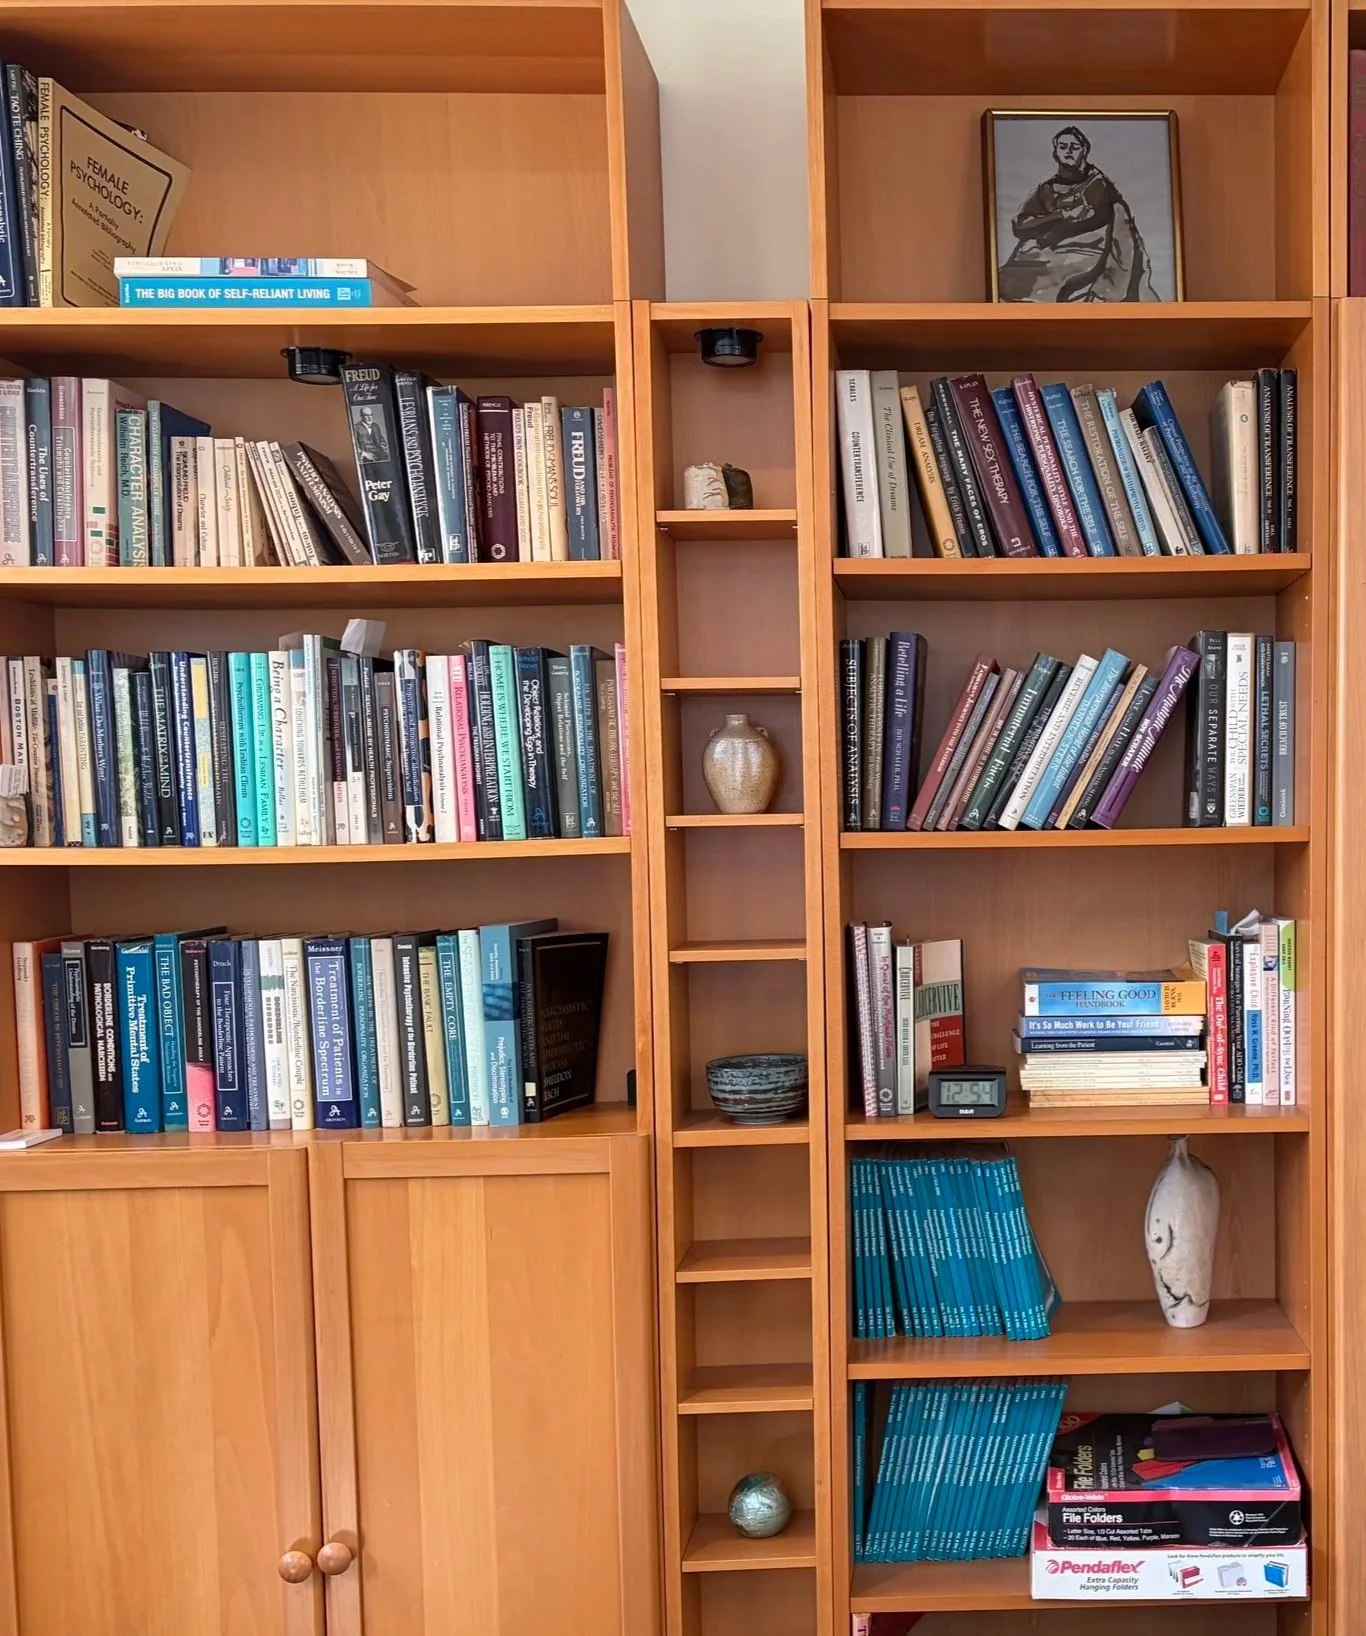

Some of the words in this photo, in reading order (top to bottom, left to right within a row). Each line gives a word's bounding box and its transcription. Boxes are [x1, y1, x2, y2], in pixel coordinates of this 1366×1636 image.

[11, 94, 19, 113] TAO
[41, 82, 49, 120] FEMALE
[12, 114, 21, 126] TE
[14, 128, 24, 160] CHING
[40, 126, 49, 200] PSYCHOLOGY:
[87, 156, 129, 195] FEMALE
[70, 161, 144, 224] PSYCHOLOGY:
[71, 199, 100, 228] Annotated
[101, 222, 136, 254] Bibliography
[135, 288, 155, 299] THE
[158, 288, 175, 299] BIG
[178, 288, 206, 298] BOOK
[209, 288, 221, 298] OF
[224, 288, 294, 298] SELF-RELIANT
[297, 288, 330, 298] LIVING
[345, 369, 380, 382] FREUD
[400, 397, 416, 435] LESBIANS
[883, 407, 891, 421] The
[969, 397, 983, 418] THE
[1286, 385, 1294, 422] ANALYSIS
[119, 417, 129, 448] Wilhelm
[884, 423, 895, 454] Clinical
[976, 419, 990, 442] NEW
[1264, 424, 1271, 434] OF
[1286, 423, 1294, 433] OF
[38, 447, 47, 464] The
[406, 436, 417, 450] AND
[571, 432, 585, 479] FREUD
[982, 443, 997, 462] SEX
[120, 453, 129, 477] Reich,
[129, 416, 143, 500] CHARACTER
[852, 432, 864, 502] COUNTERTRANSFERENCE
[887, 456, 895, 469] Use
[1264, 435, 1272, 496] TRANSFERENCE
[1286, 435, 1294, 495] TRANSFERENCE
[28, 424, 38, 522] Countertransference
[39, 467, 47, 489] Uses
[365, 480, 392, 491] Peter
[407, 450, 428, 517] PSYCHOANALYSIS
[989, 464, 1009, 504] THERAPY
[40, 492, 49, 502] of
[122, 480, 131, 498] M.D.
[368, 491, 390, 502] Gay
[889, 482, 898, 511] Dreams
[270, 660, 284, 693] Being
[494, 661, 503, 691] HOME
[894, 641, 910, 686] Retelling
[1174, 665, 1191, 688] The
[155, 687, 165, 708] THE
[497, 693, 504, 701] IS
[531, 680, 539, 704] Object
[844, 659, 857, 720] SUBJECTS
[1209, 684, 1219, 704] OUR
[1239, 672, 1248, 712] NEEDS
[498, 703, 507, 737] WHERE
[522, 694, 534, 735] Developing
[894, 698, 908, 717] Life
[1000, 688, 1038, 752] Immaterial
[1153, 684, 1178, 730] Analytic
[1261, 691, 1269, 727] LETHAL
[157, 711, 167, 754] MATRIX
[435, 706, 443, 739] Relational
[532, 706, 542, 738] Relations
[848, 724, 857, 741] OF
[1139, 718, 1150, 733] ROY
[1207, 709, 1218, 763] SEPARATE
[274, 708, 287, 770] Character
[501, 740, 509, 756] WE
[1121, 734, 1144, 767] SCHAFER
[1131, 727, 1161, 772] Attitude
[1238, 720, 1247, 764] SPECIAL
[1260, 729, 1269, 769] SECRETS
[436, 742, 446, 791] Psychoanalysis
[503, 758, 512, 788] START
[527, 760, 536, 788] Therapy
[847, 744, 858, 804] ANALYSIS
[983, 759, 1005, 788] Facts
[1207, 767, 1216, 793] WAYS
[160, 765, 171, 798] MIND
[505, 790, 514, 816] FROM
[160, 956, 171, 975] THE
[314, 962, 322, 974] the
[402, 957, 411, 983] Intensive
[443, 960, 452, 978] THE
[126, 967, 137, 1018] Primitive
[162, 979, 172, 999] BAD
[327, 961, 342, 1021] Treatment
[444, 982, 454, 1011] EMPTY
[1061, 991, 1115, 1000] FEELING
[1118, 990, 1156, 1000] GOOD
[1216, 996, 1224, 1011] The
[94, 983, 104, 1038] PATHOLOGICAL
[103, 983, 113, 1026] BORDERLINE
[315, 977, 328, 1038] Borderline
[402, 984, 415, 1026] Psychotherapy
[1076, 1000, 1124, 1008] HANDBOOK
[137, 994, 147, 1051] Treatment
[164, 1001, 174, 1038] OBJECT
[332, 1024, 343, 1035] of
[447, 1016, 456, 1040] CORE
[1029, 1020, 1041, 1030] It's
[1043, 1020, 1052, 1030] So
[1054, 1020, 1073, 1030] Much
[1076, 1020, 1094, 1029] Work
[1096, 1020, 1103, 1029] to
[1106, 1020, 1115, 1028] Be
[1118, 1020, 1134, 1028] Your
[1136, 1020, 1160, 1028] Friend
[1252, 1029, 1258, 1037] W.
[106, 1029, 115, 1072] CONDITIONS
[129, 1020, 138, 1057] Mental
[1215, 1015, 1225, 1065] Out-of-Sync
[1250, 1038, 1259, 1062] Greene,
[97, 1040, 106, 1081] NARCISSISM
[140, 1053, 149, 1063] of
[318, 1041, 331, 1096] Spectrum
[333, 1039, 346, 1085] Patients
[407, 1042, 417, 1071] Borderline
[131, 1059, 140, 1093] States
[410, 1073, 419, 1094] Patient
[1217, 1068, 1225, 1090] Child
[335, 1087, 342, 1095] in
[945, 1083, 994, 1103] 12:54
[1063, 1513, 1081, 1523] File
[1084, 1513, 1123, 1523] Folders
[1061, 1560, 1146, 1574] Pendaflex
[1107, 1577, 1139, 1585] Capacity
